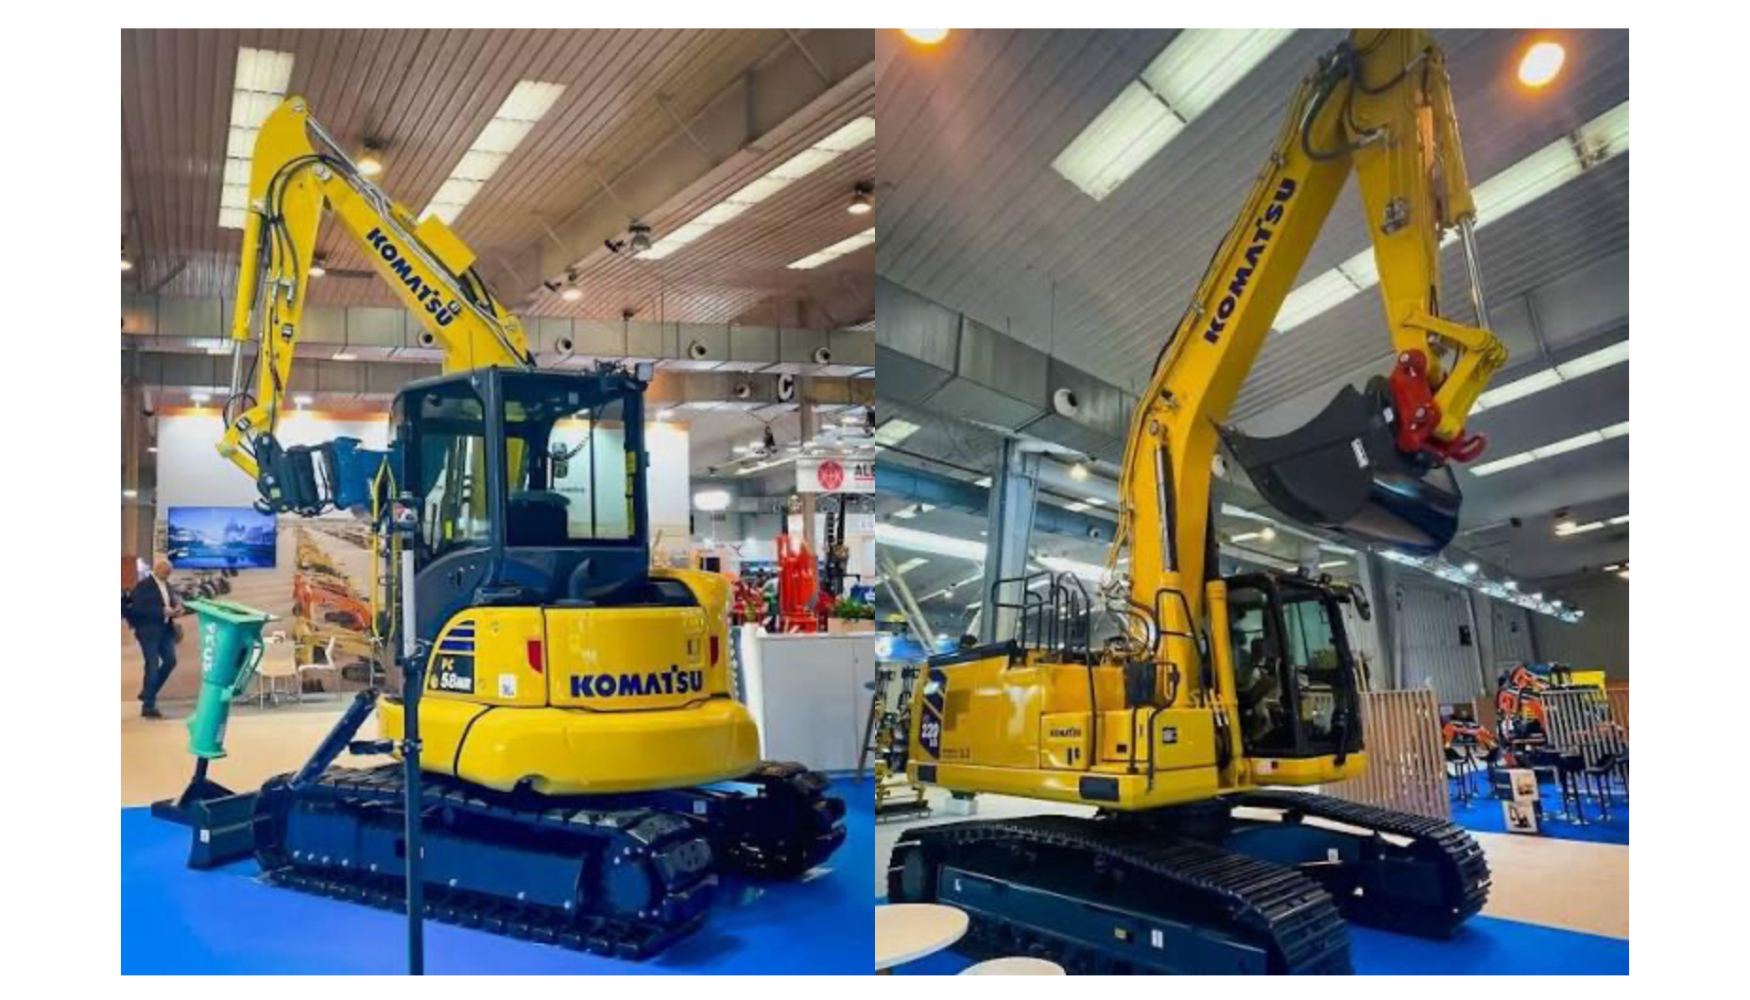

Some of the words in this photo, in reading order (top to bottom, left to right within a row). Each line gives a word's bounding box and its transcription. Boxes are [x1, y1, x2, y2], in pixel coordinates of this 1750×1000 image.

[366, 227, 454, 326] KOMATSU
[1204, 178, 1296, 344] KOMATSU
[778, 373, 793, 401] C
[570, 664, 703, 698] KOMATSU
